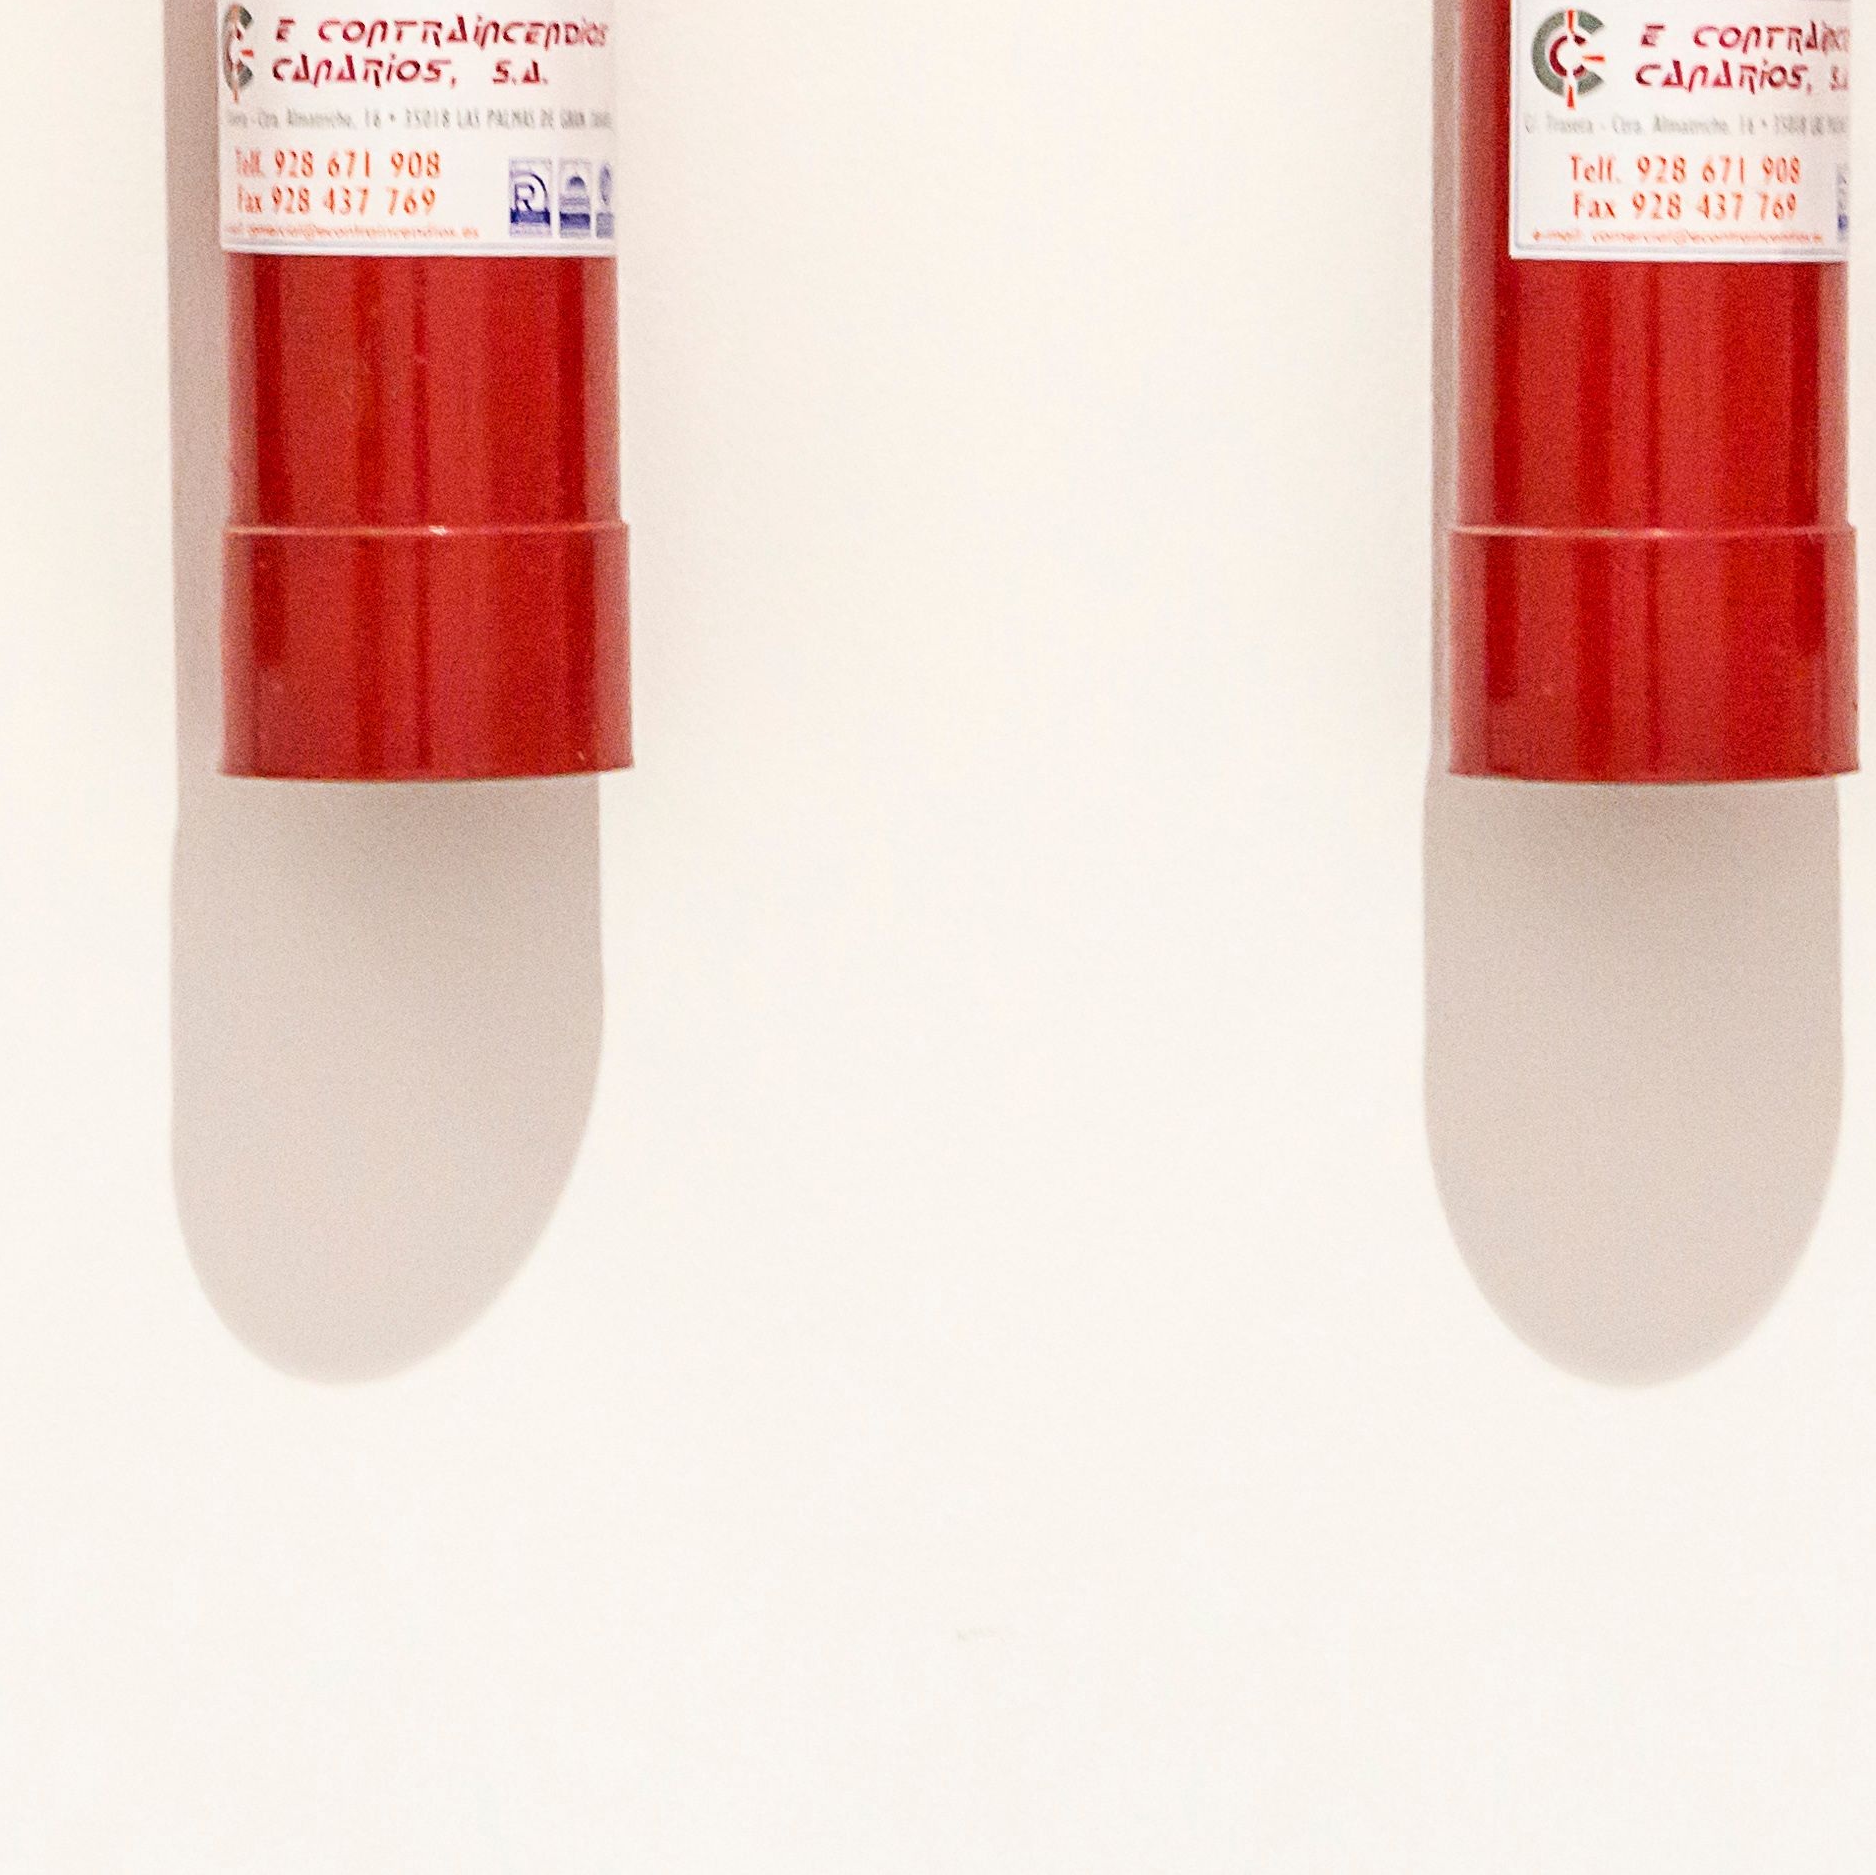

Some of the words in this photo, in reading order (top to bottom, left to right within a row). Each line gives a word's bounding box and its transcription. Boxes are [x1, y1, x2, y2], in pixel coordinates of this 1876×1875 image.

[275, 16, 297, 43] E
[1640, 22, 1666, 49] E
[273, 147, 315, 178] 928
[327, 147, 373, 178] 671
[389, 147, 443, 179] 908
[1569, 153, 1621, 185] Telf.
[1636, 154, 1687, 185] 928
[1701, 154, 1746, 185] 671
[1762, 154, 1802, 185] 908
[270, 187, 312, 215] 928
[323, 187, 371, 215] 437
[385, 187, 438, 215] 769
[1572, 190, 1617, 221] Fax
[1632, 190, 1682, 220] 928
[1697, 190, 1744, 220] 437
[1757, 190, 1798, 220] 769
